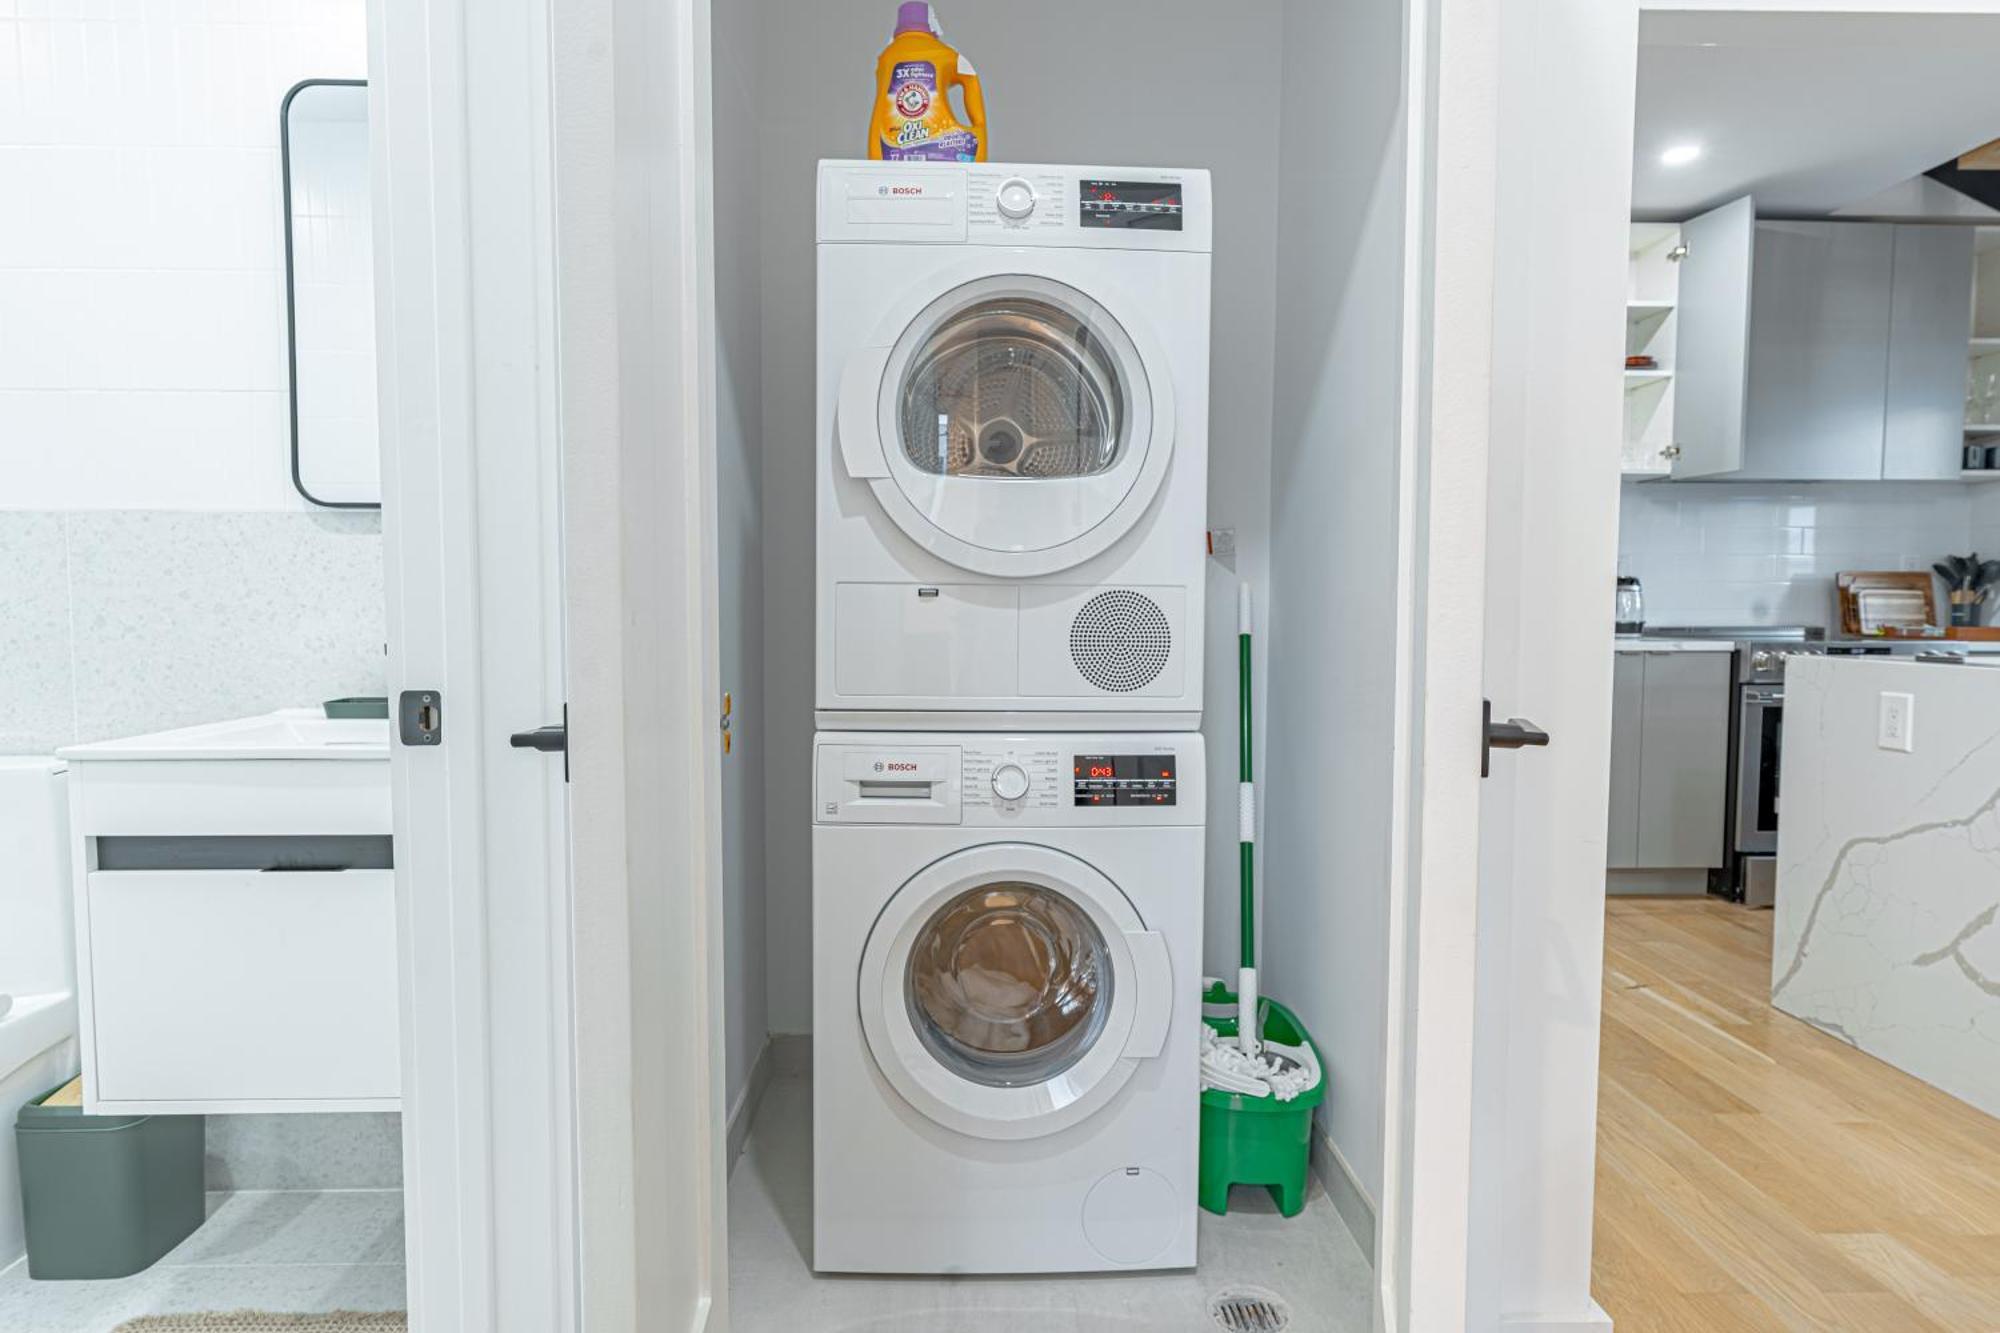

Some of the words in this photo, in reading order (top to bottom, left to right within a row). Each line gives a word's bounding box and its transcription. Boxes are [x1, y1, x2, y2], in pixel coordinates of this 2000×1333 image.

[896, 69, 909, 78] 3X
[904, 121, 922, 132] OXI
[897, 128, 929, 145] CLEAN
[892, 187, 922, 195] BOSCH
[887, 763, 917, 771] BOSCH
